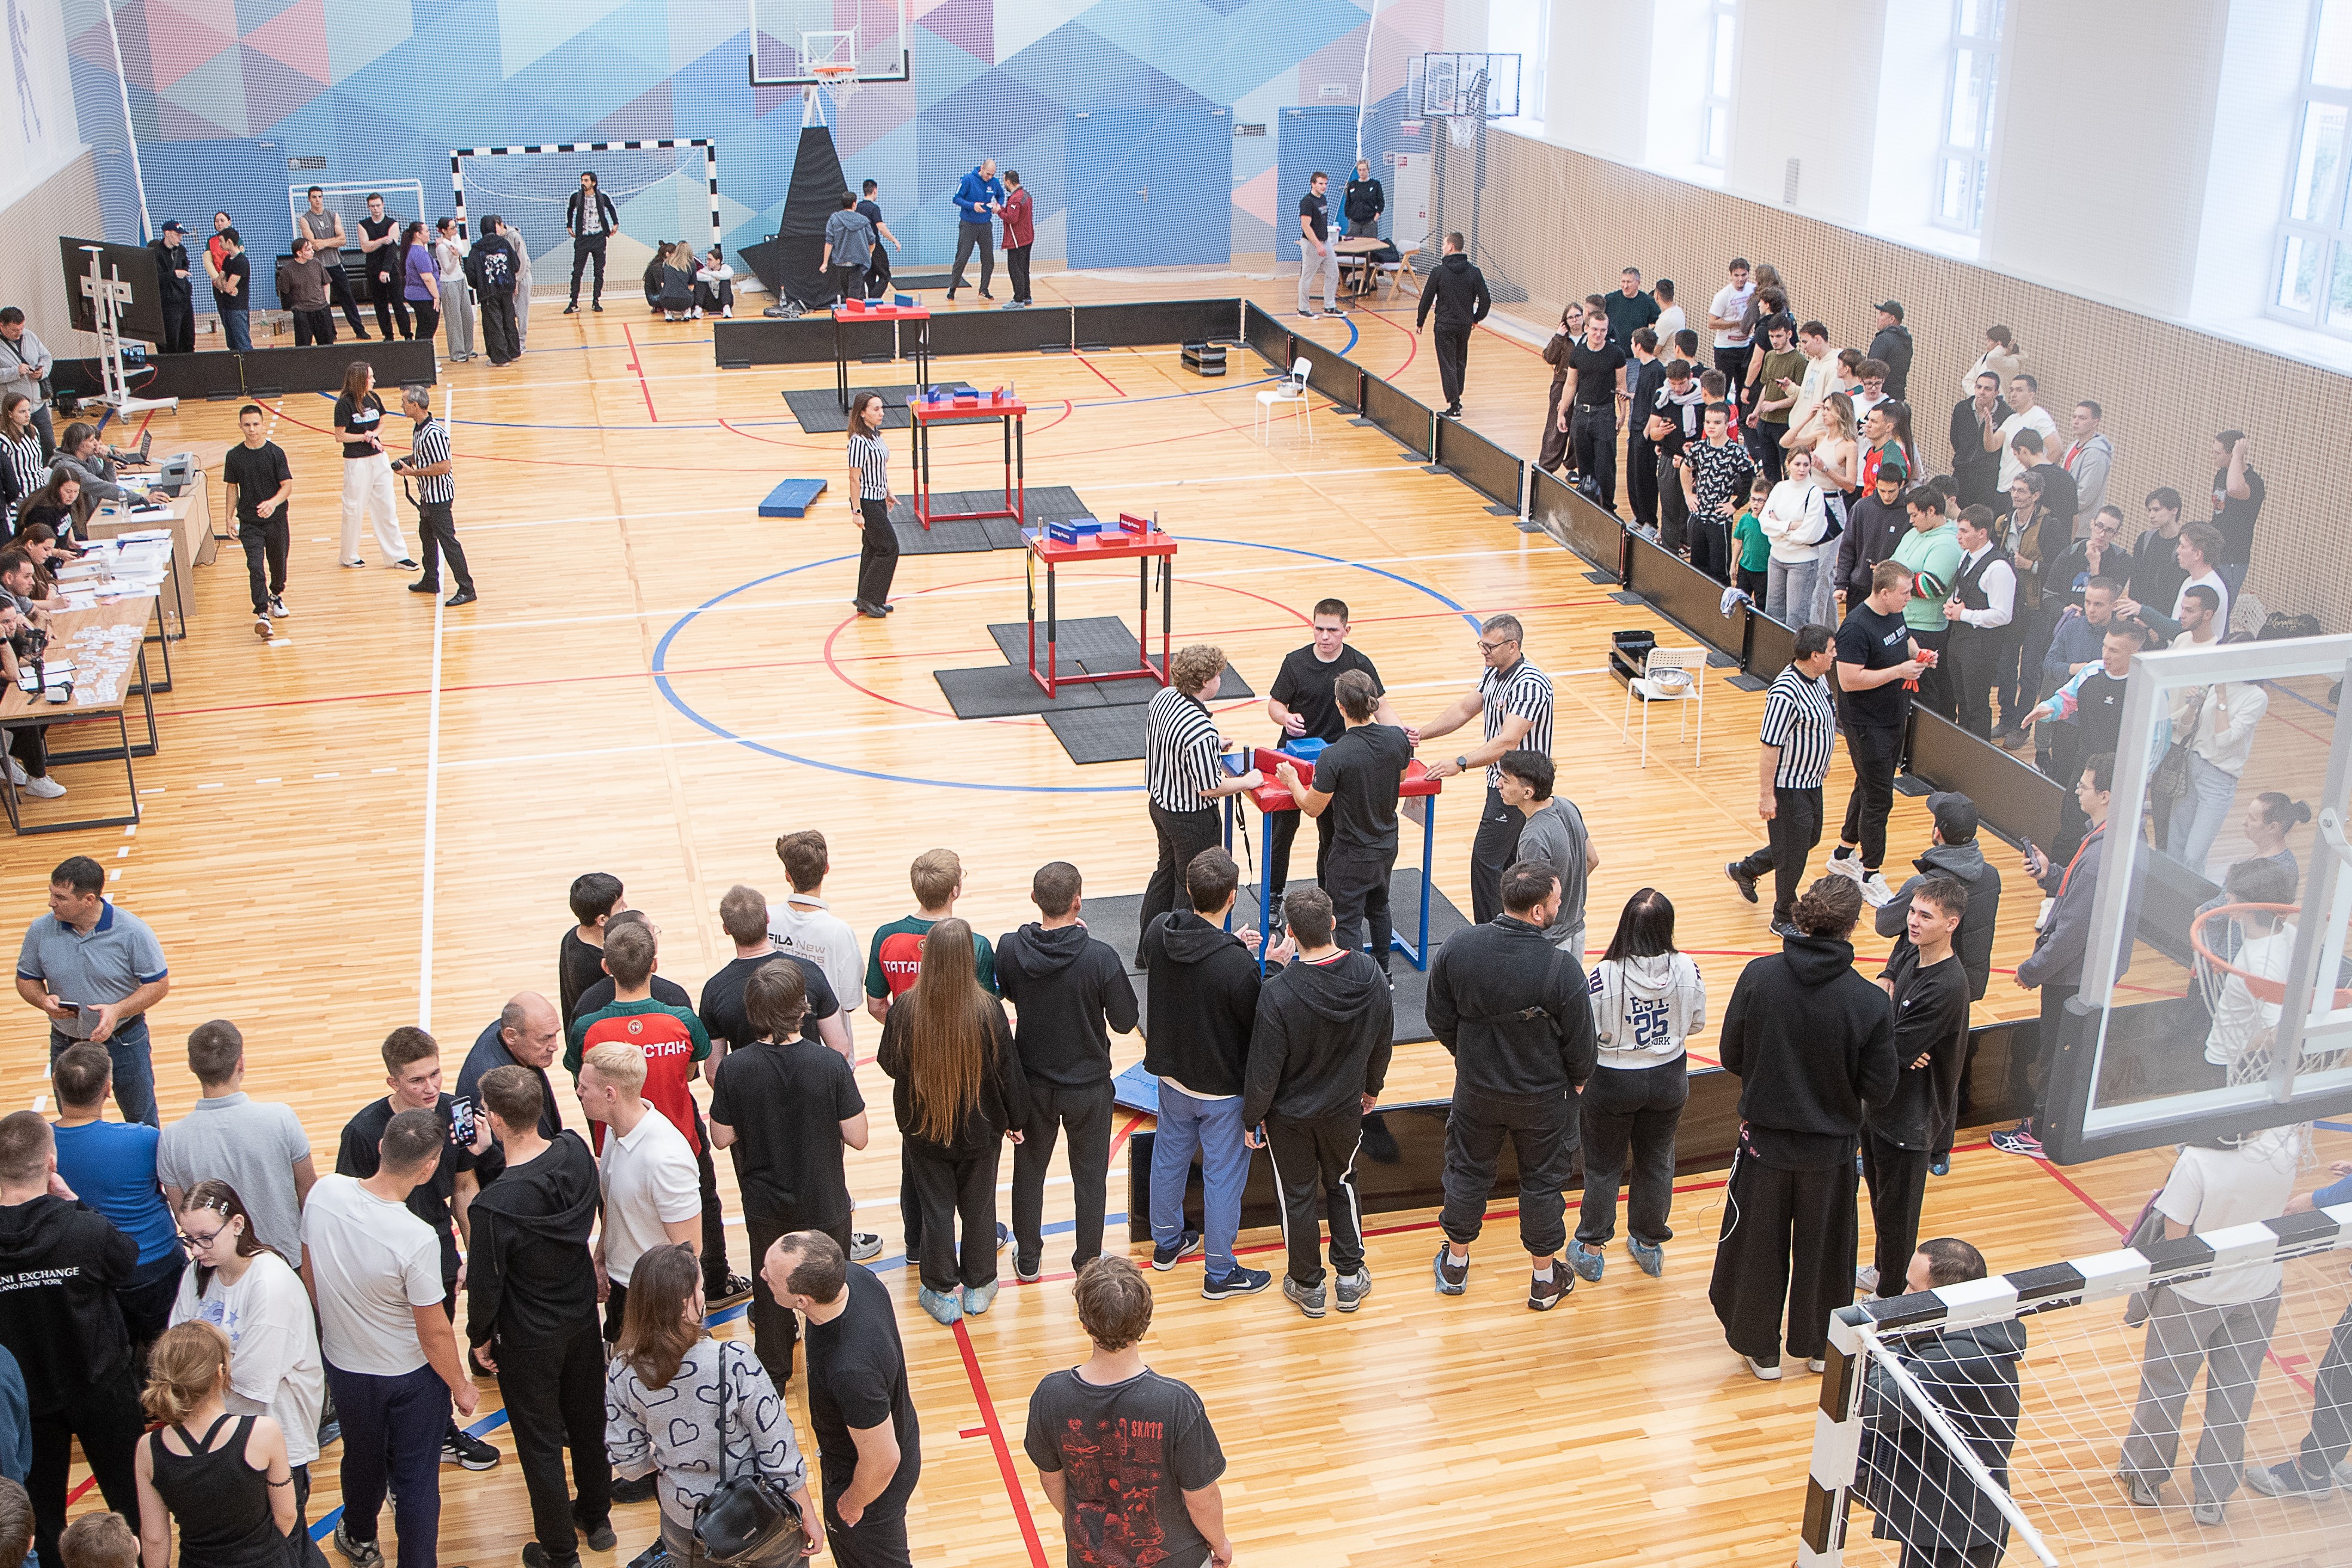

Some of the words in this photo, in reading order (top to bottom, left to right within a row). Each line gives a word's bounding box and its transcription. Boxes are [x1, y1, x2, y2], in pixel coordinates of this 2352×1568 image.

[768, 933, 793, 946] FILA
[796, 939, 825, 954] New
[1625, 1007, 1669, 1046] '25
[19, 1267, 79, 1282] EXCHANGE
[1131, 1419, 1163, 1440] SKATE
